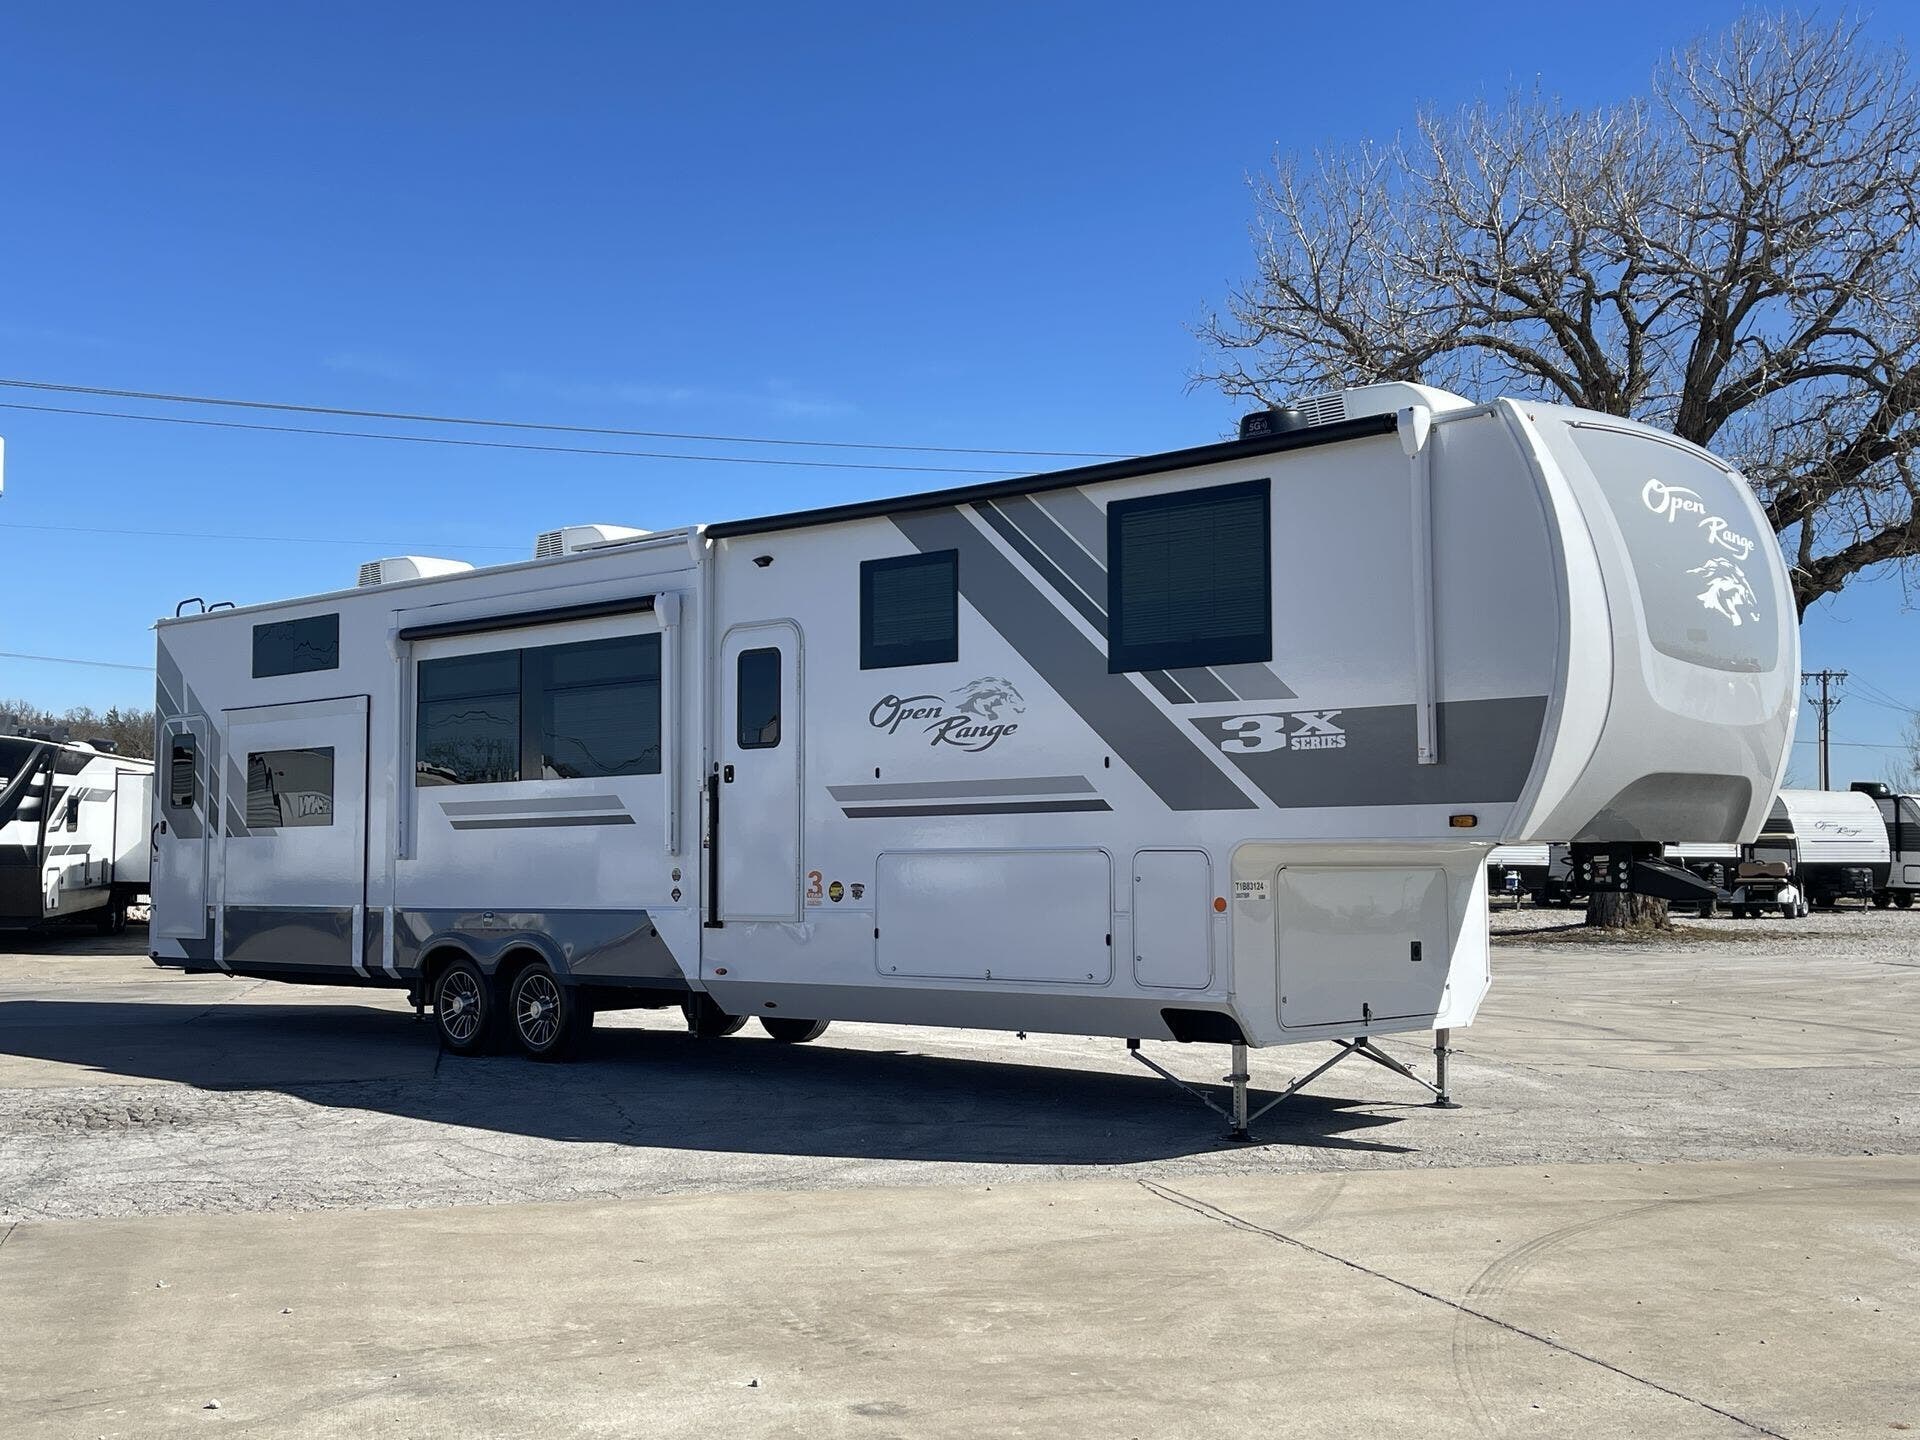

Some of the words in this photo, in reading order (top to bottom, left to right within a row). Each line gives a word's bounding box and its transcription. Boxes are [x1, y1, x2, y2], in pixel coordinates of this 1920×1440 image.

[1248, 421, 1261, 431] 5G
[1642, 478, 1706, 523] Open
[1698, 516, 1755, 560] Range
[869, 694, 946, 735] Open
[923, 715, 1018, 752] Range
[1291, 735, 1346, 750] SERIES
